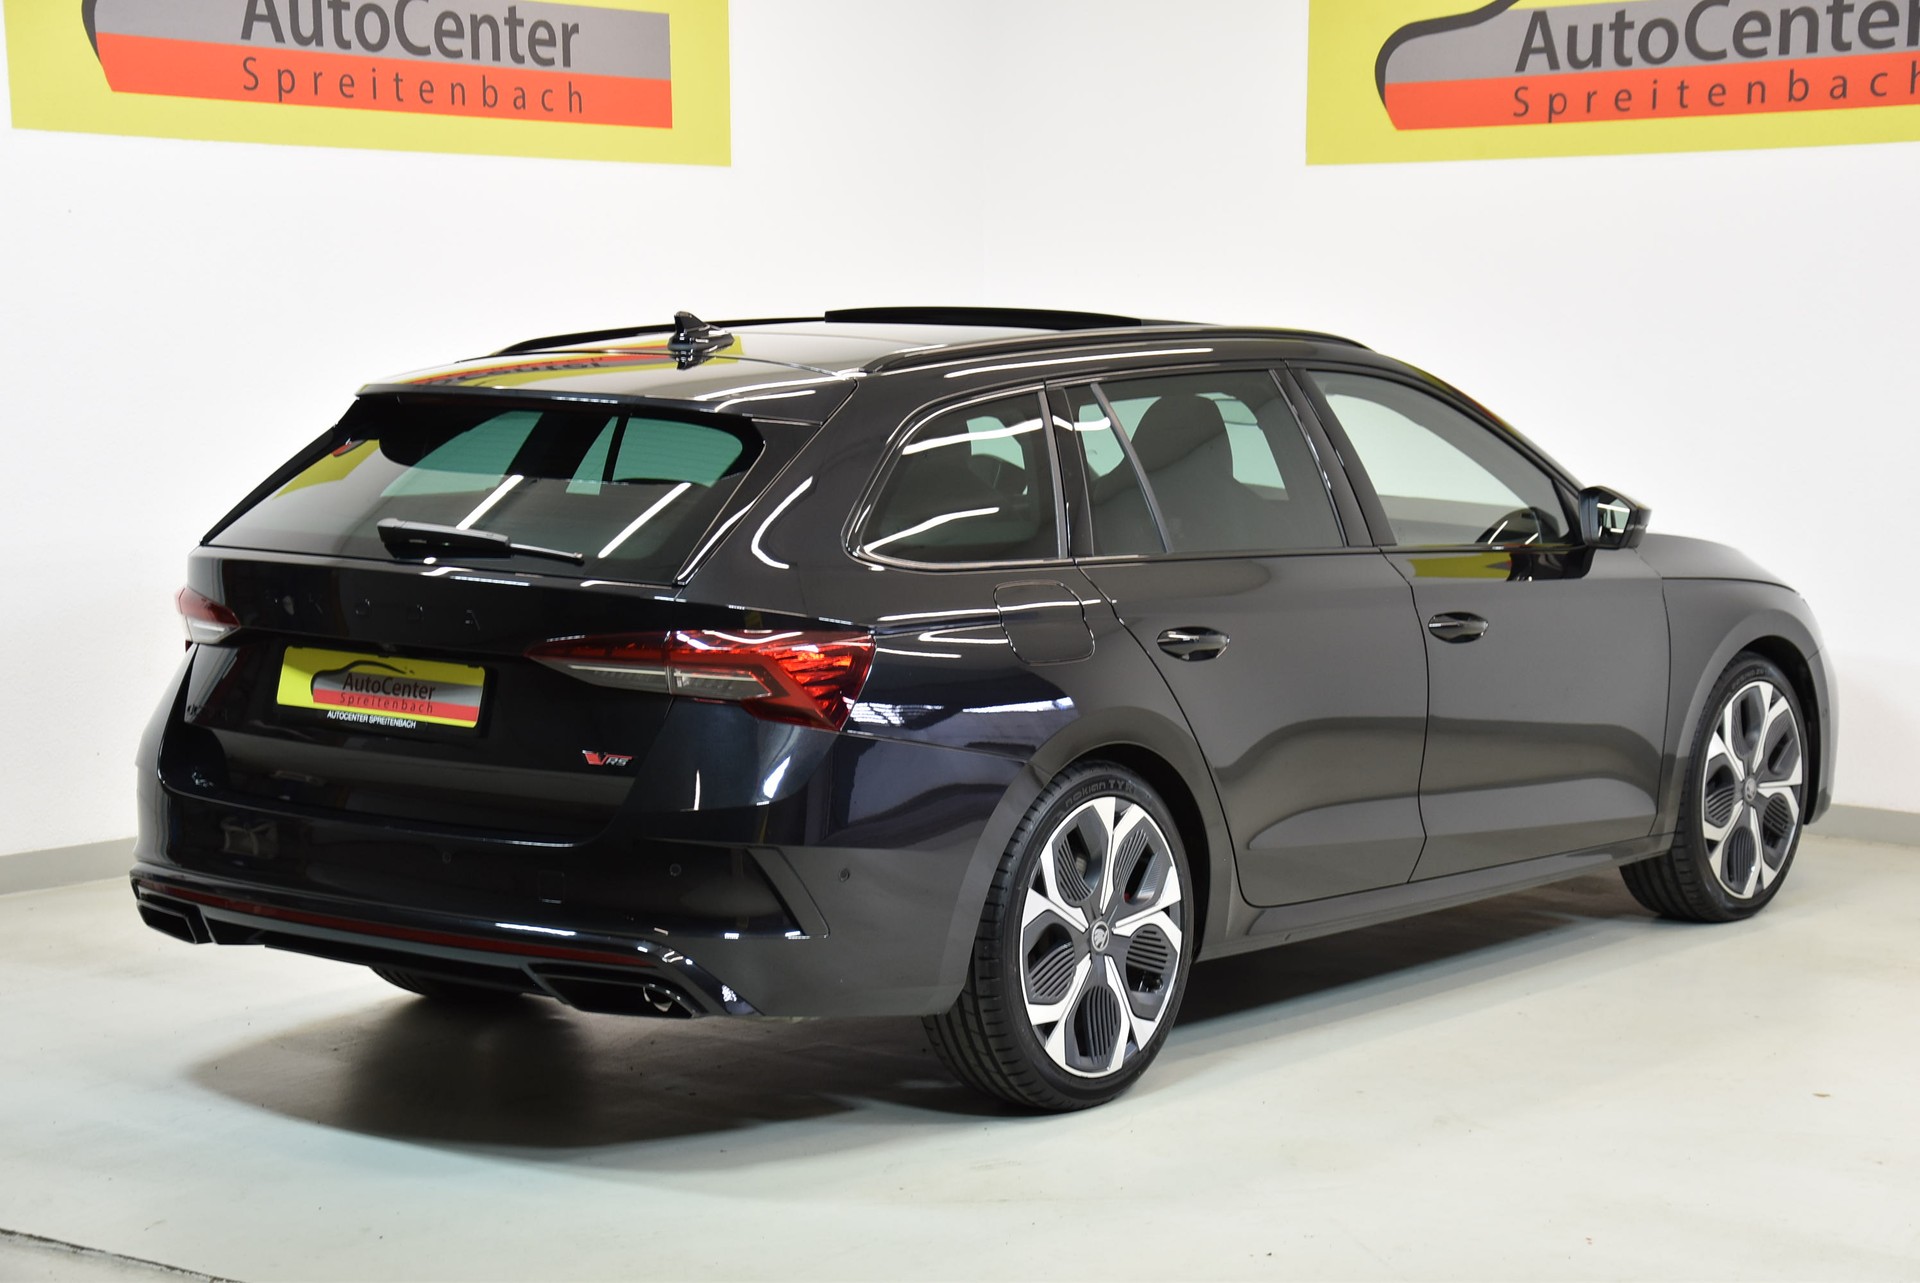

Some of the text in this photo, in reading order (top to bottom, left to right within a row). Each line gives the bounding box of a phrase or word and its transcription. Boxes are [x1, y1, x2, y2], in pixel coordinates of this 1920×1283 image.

[240, 0, 580, 69] AutoCenter
[242, 57, 584, 114] Spreitenbach
[342, 672, 436, 700] AutoCenter
[340, 692, 433, 714] Spreitenbach
[327, 710, 417, 729] AUTOCENTER SPREITENBACH
